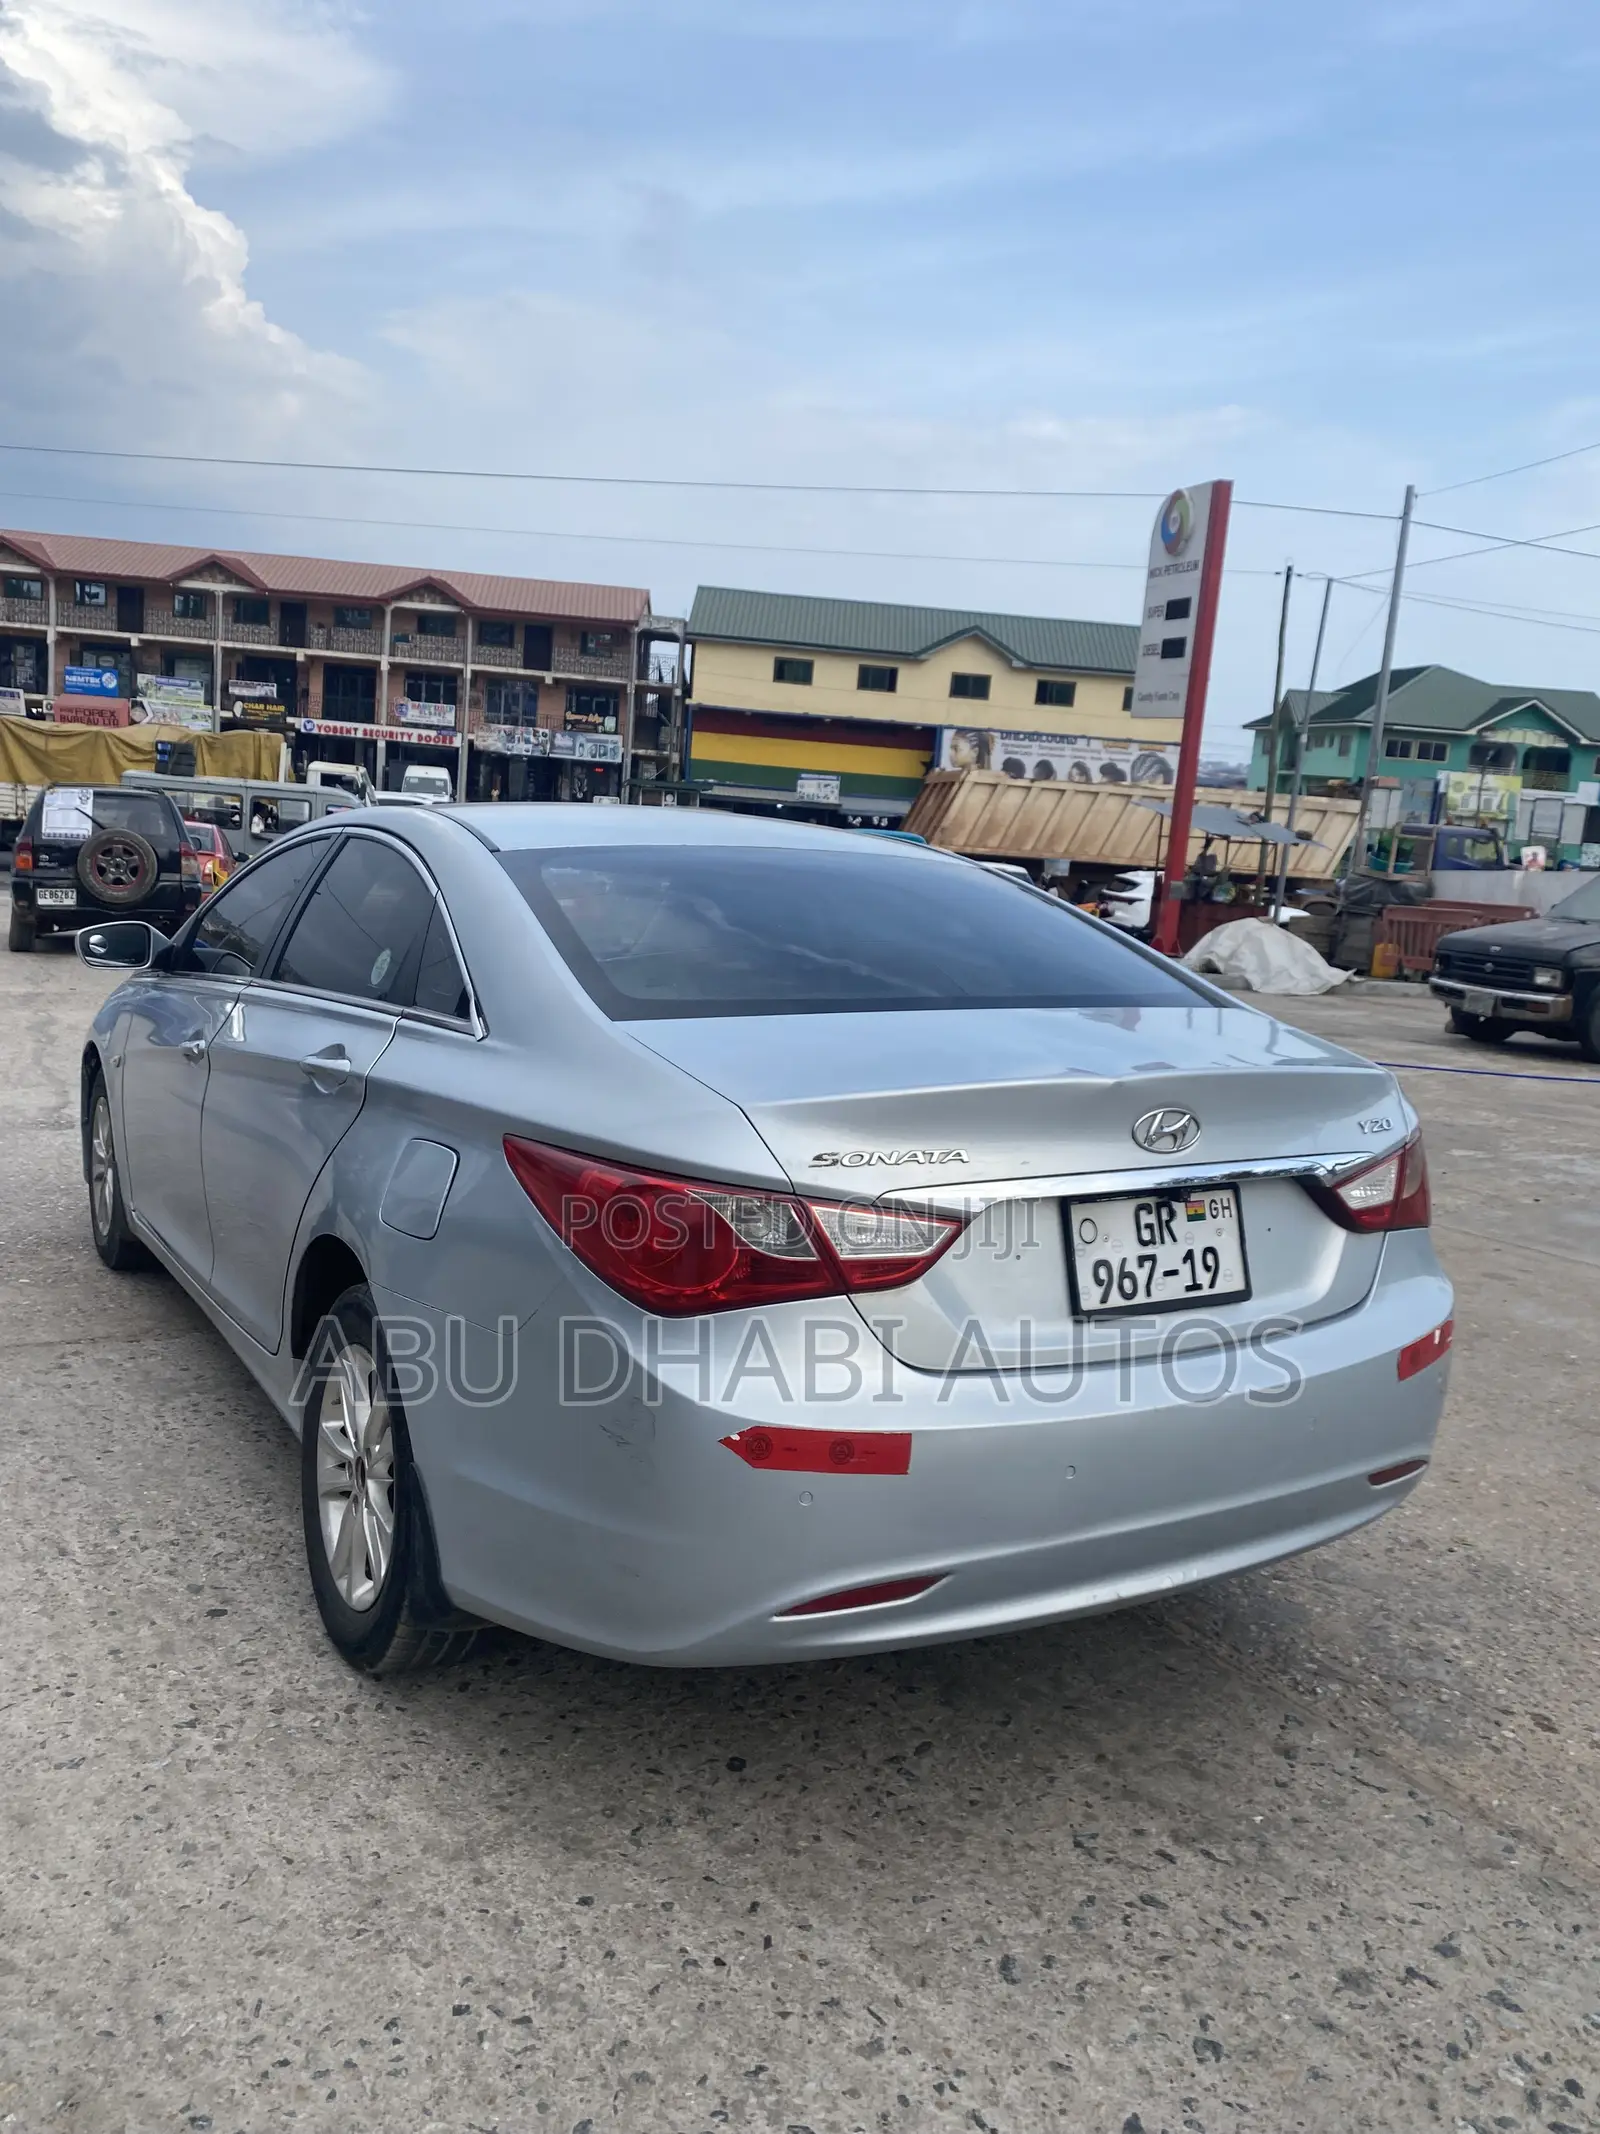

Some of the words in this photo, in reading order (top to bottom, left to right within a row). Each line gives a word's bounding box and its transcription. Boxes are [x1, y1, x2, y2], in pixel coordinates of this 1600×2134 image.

[60, 714, 99, 725] BUREAU
[103, 717, 119, 727] LTD
[75, 707, 117, 718] FOREX
[362, 728, 413, 742] SECURITY
[417, 733, 454, 745] DOORS
[1358, 1117, 1393, 1134] Y20
[808, 1149, 970, 1168] SONATA
[1134, 1200, 1178, 1247] GR
[1209, 1197, 1233, 1219] GH
[1092, 1246, 1220, 1304] 967-19
